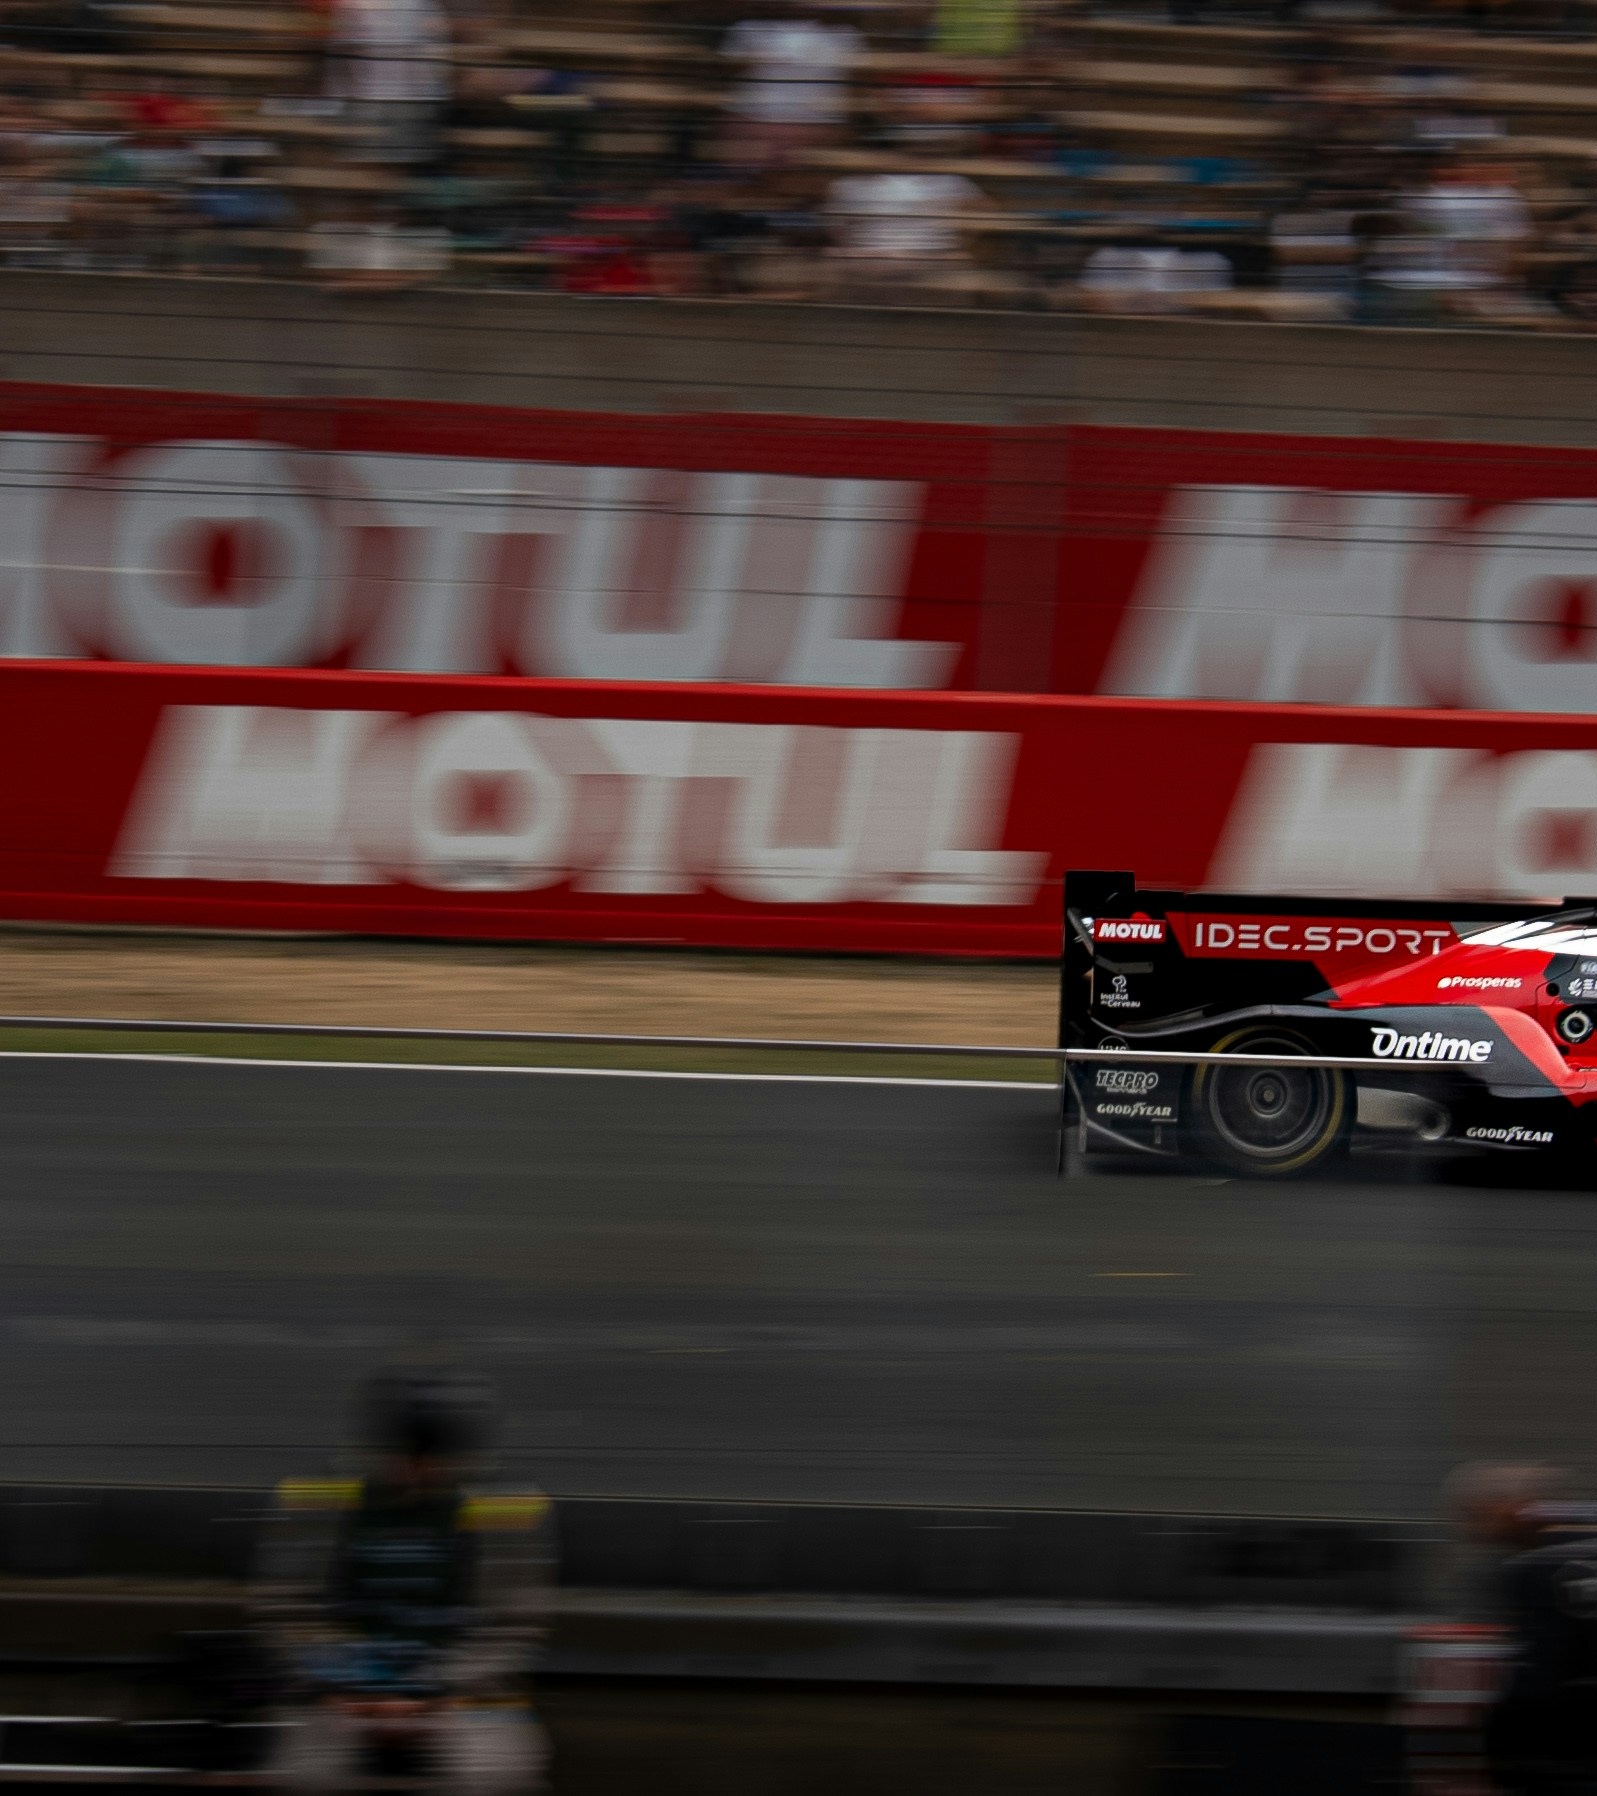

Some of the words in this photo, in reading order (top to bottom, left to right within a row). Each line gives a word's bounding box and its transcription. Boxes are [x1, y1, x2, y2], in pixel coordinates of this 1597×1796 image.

[105, 704, 1051, 905] MOTUL
[1098, 922, 1163, 939] MOTUL
[1195, 922, 1451, 956] IDEC.SPORT
[1451, 976, 1522, 990] Prosperas
[1370, 1027, 1493, 1062] Ontime
[1096, 1069, 1159, 1090] TECPRO
[1096, 1102, 1172, 1117] GOODYEAR
[1466, 1126, 1554, 1142] GOODYEAR
